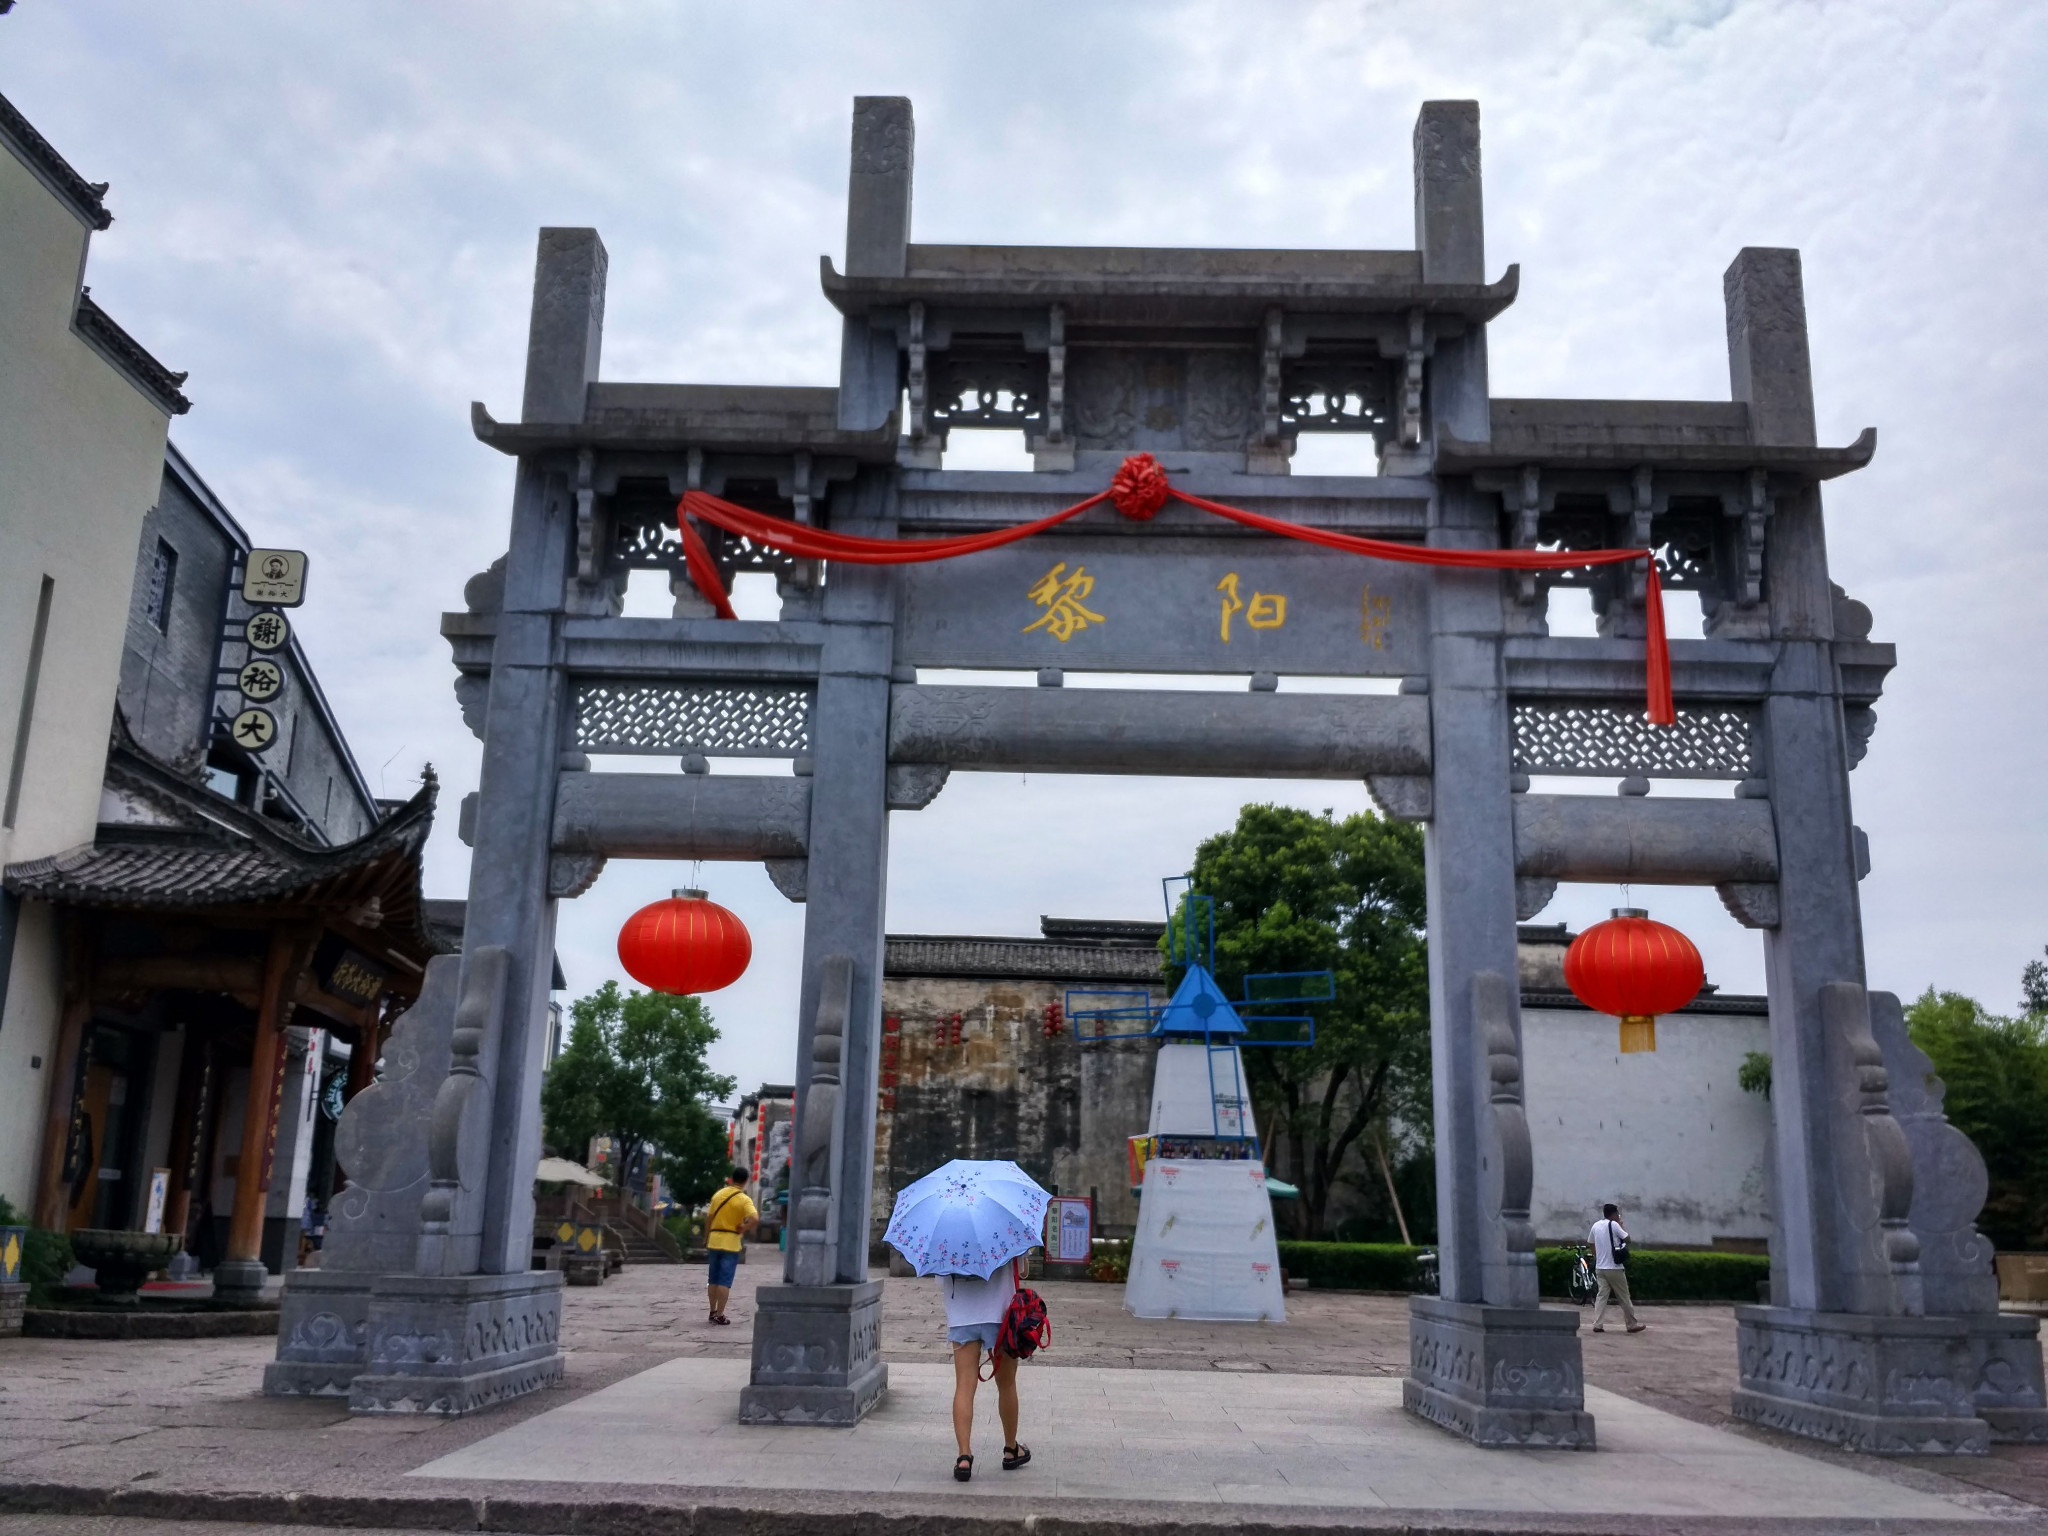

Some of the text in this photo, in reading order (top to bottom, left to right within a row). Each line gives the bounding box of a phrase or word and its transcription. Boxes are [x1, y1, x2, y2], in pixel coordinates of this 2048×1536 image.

[1022, 561, 1287, 643] 黎阳
[235, 616, 282, 743] 謝裕大
